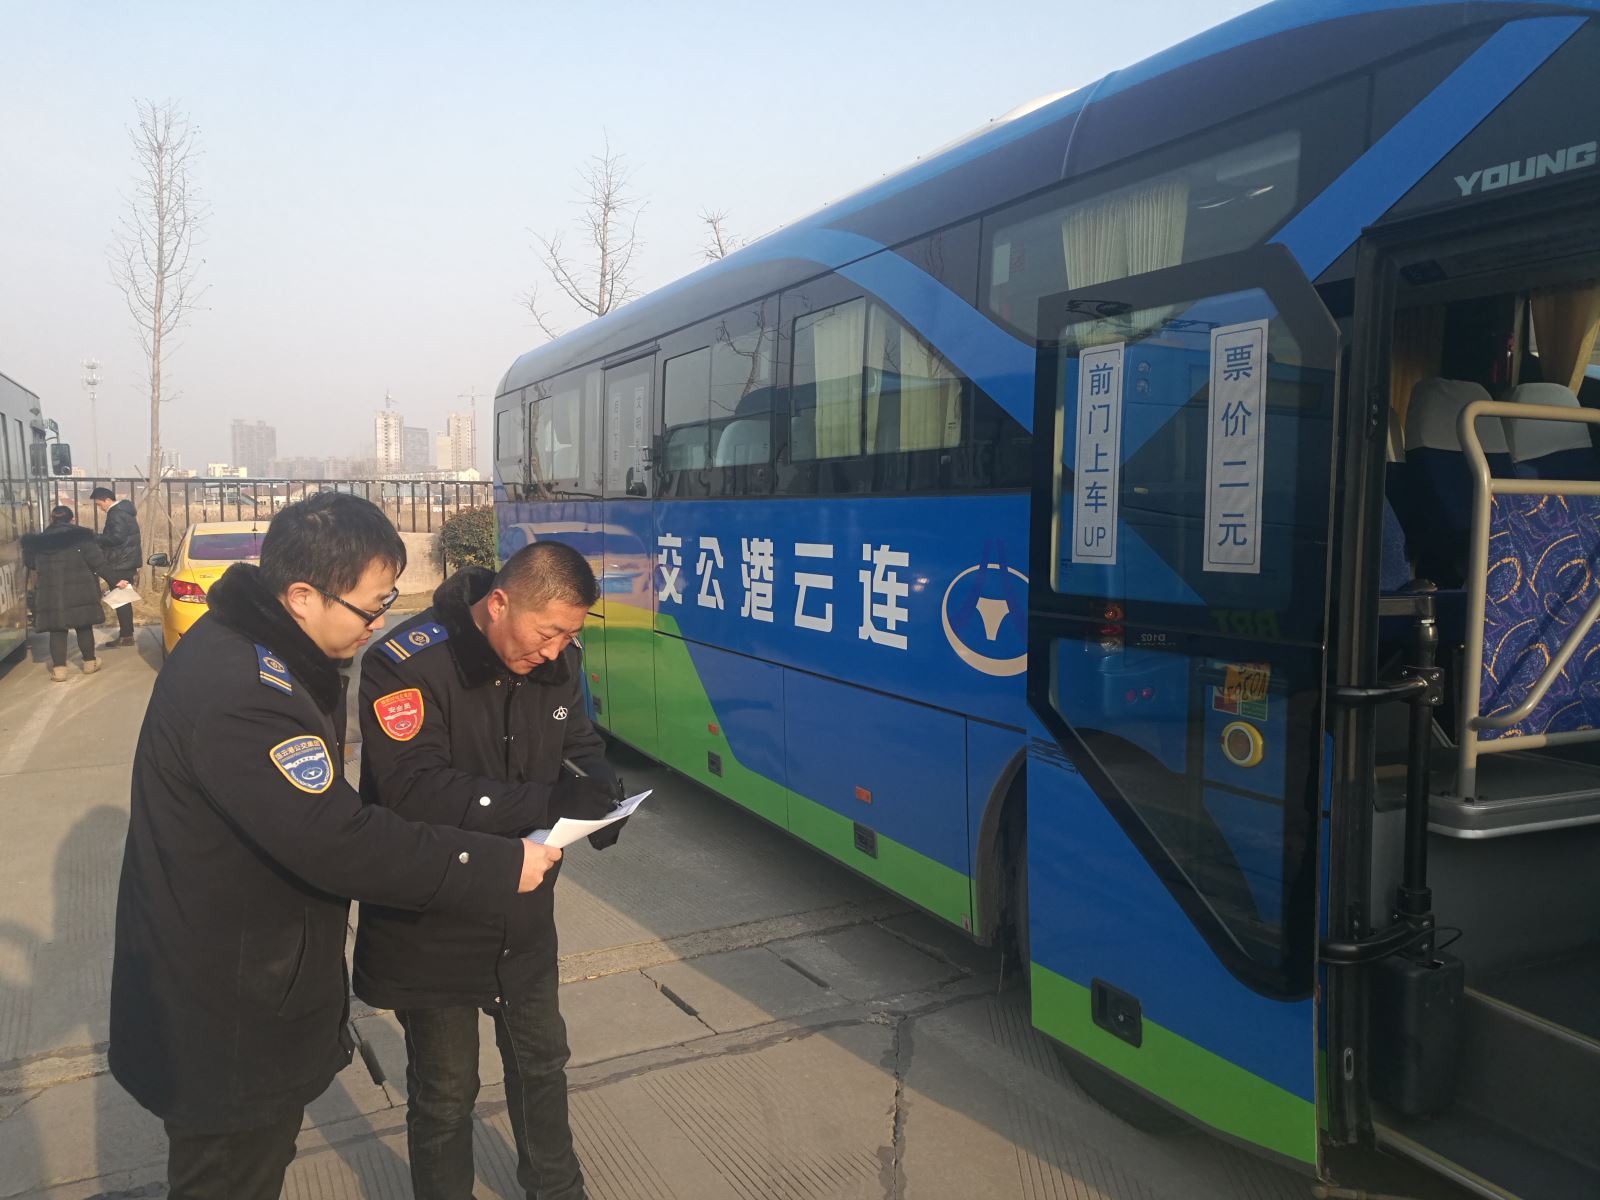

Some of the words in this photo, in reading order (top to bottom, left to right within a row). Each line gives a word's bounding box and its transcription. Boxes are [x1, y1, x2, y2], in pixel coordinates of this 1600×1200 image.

[1454, 140, 1598, 198] YOUNG
[1084, 361, 1114, 514] 前门上车
[1217, 343, 1254, 547] 票价二元
[1083, 526, 1107, 548] UP
